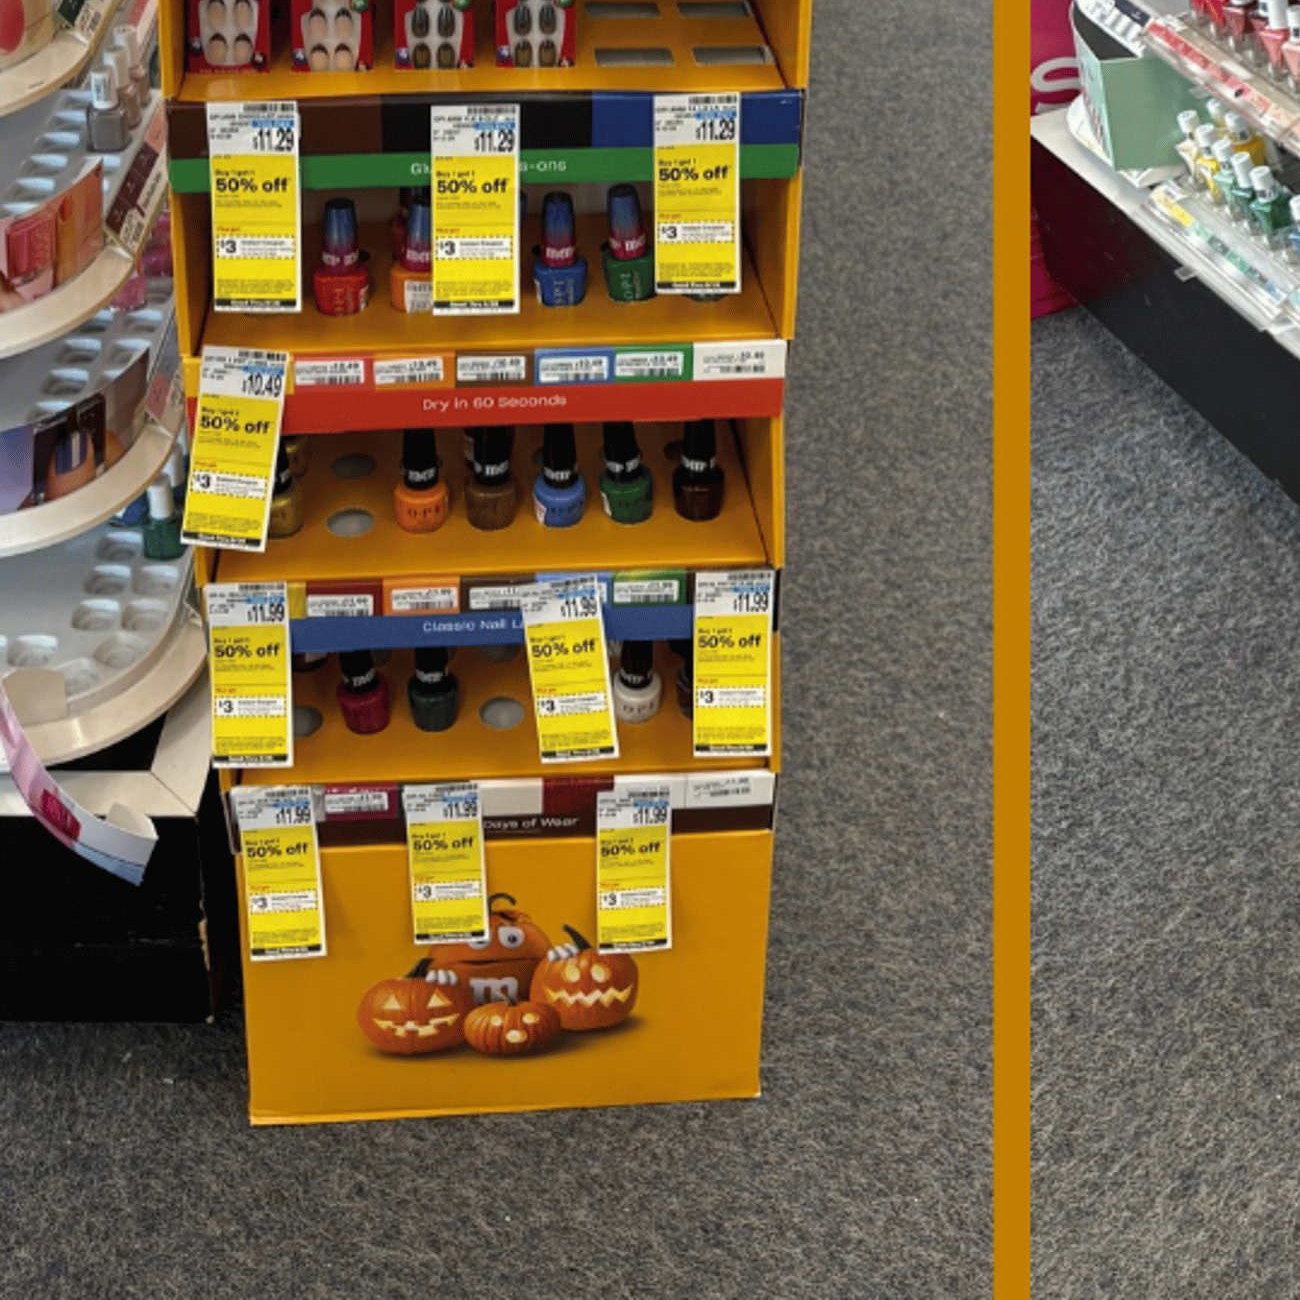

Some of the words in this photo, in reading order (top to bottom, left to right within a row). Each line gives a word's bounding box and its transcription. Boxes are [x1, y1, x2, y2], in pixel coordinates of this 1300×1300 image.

[696, 120, 735, 141] $11.29
[253, 129, 294, 153] $11.29
[474, 130, 514, 152] $11.29
[659, 166, 699, 181] 50%
[216, 177, 258, 193] 50%
[437, 179, 478, 194] 50%
[423, 399, 448, 411] Dry
[455, 398, 468, 409] in
[473, 397, 495, 408] 60
[498, 393, 567, 408] Seconds
[200, 415, 240, 433] 50%
[423, 620, 475, 632] Classic
[480, 618, 506, 630] Nail
[698, 635, 735, 649] 50%
[214, 644, 252, 659] 50%
[531, 643, 569, 658] 50%
[521, 817, 537, 828] of
[541, 815, 579, 827] Wear
[247, 844, 282, 859] 50%
[413, 839, 448, 852] 50%
[601, 843, 635, 857] 50%
